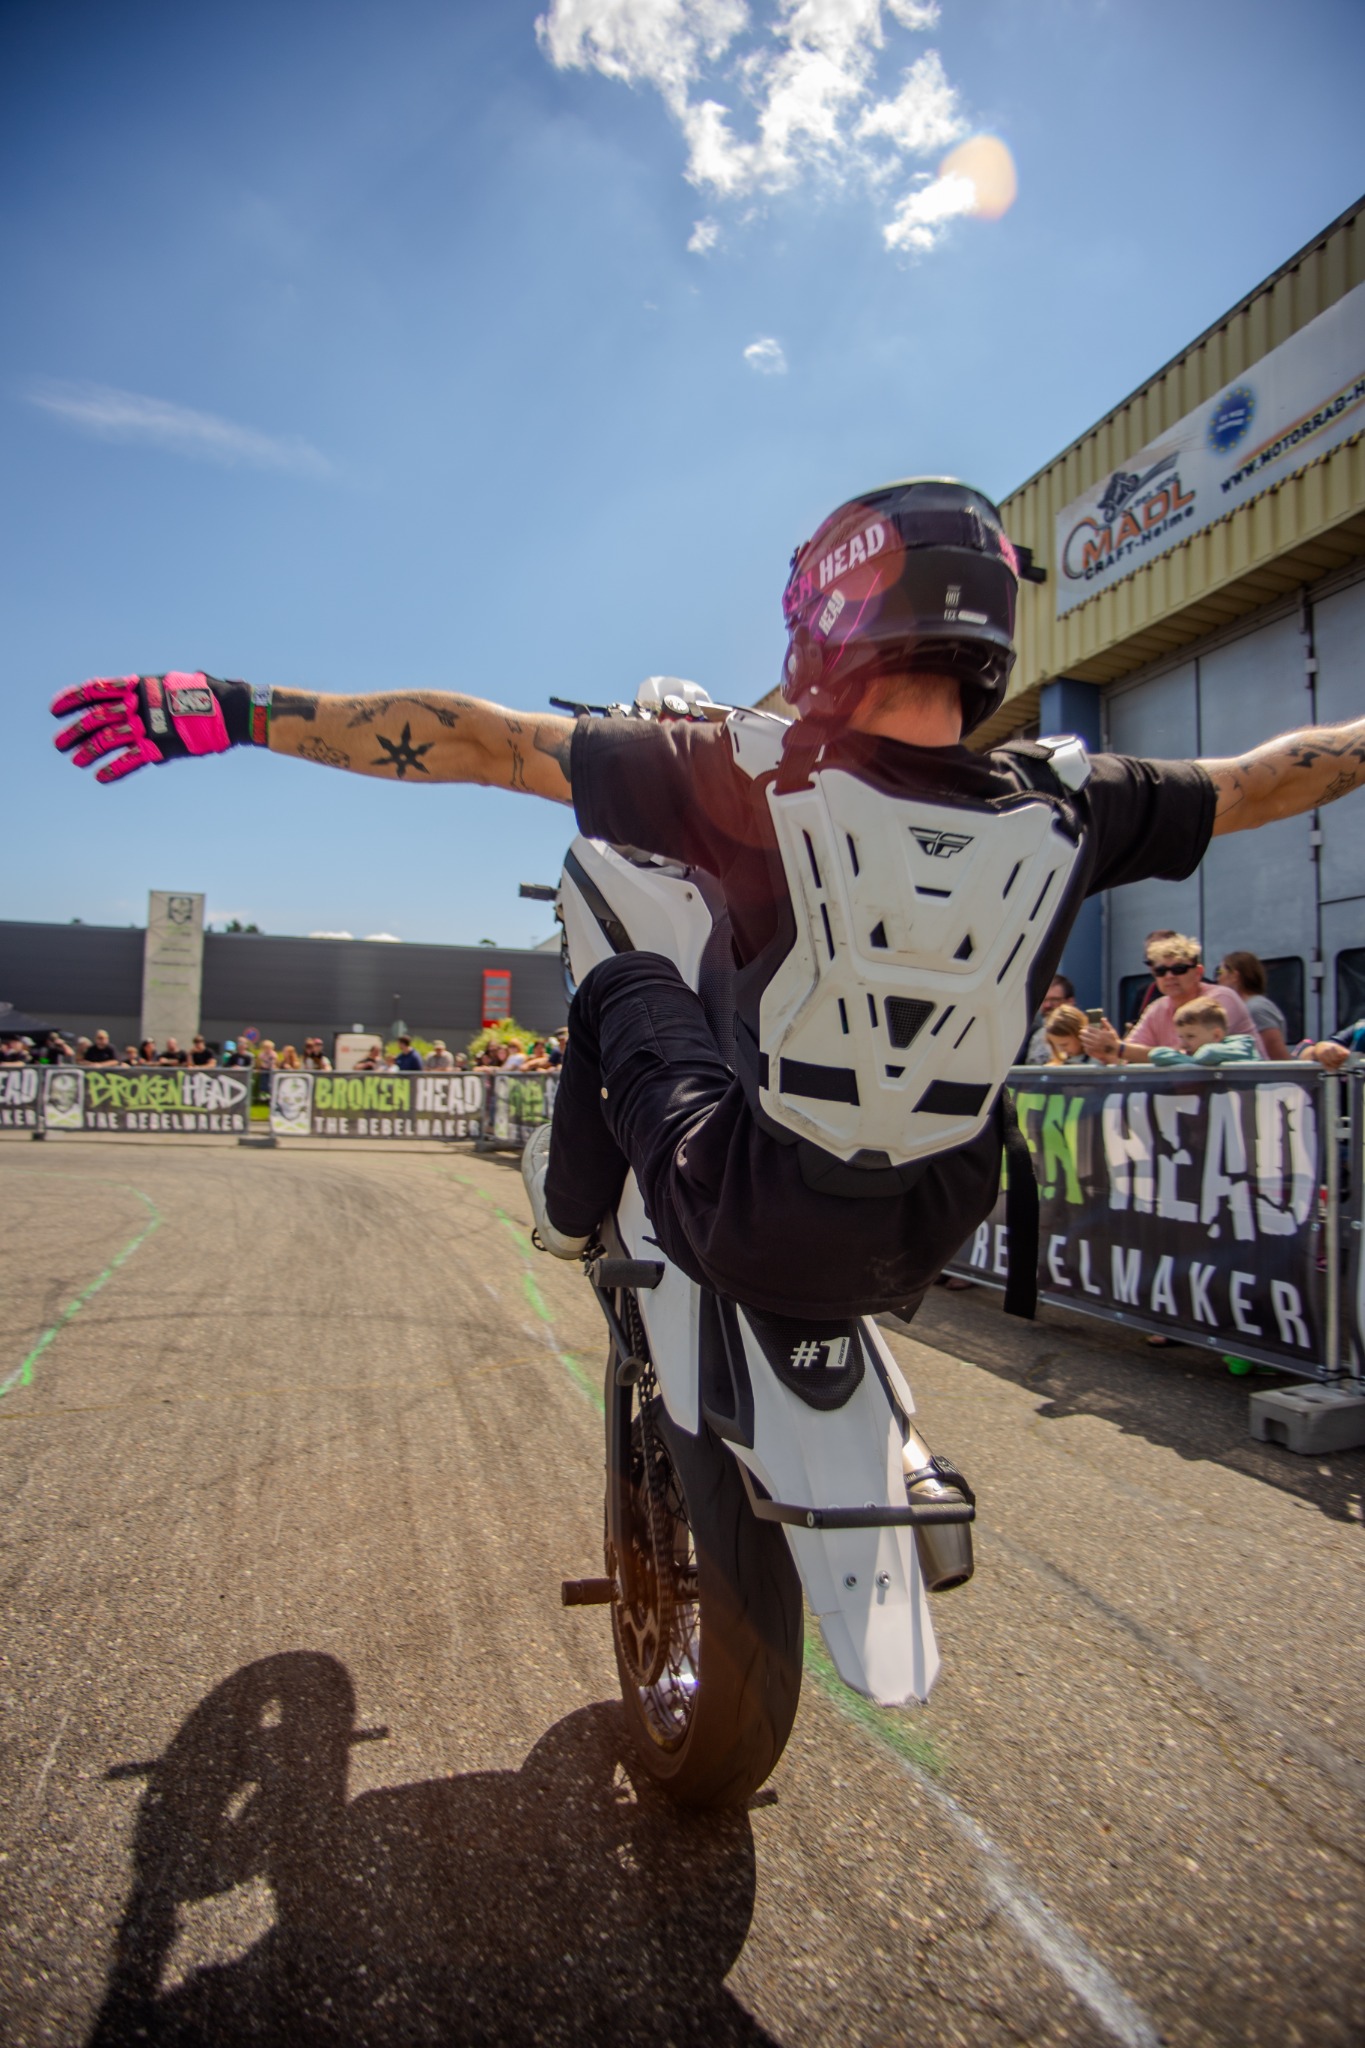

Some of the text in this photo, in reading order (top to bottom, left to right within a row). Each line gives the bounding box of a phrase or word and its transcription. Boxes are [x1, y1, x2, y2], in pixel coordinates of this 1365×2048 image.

[819, 523, 885, 589] HEAD
[818, 589, 846, 636] HEAD
[314, 1076, 411, 1111] BROKEN
[416, 1075, 483, 1115] HEAD
[86, 1111, 245, 1131] THE REBELMAKER
[314, 1117, 481, 1136] THE REBELMAKER
[1102, 1082, 1317, 1242] HEAD
[970, 1221, 1310, 1349] REELMAKER
[790, 1336, 851, 1368] #1
